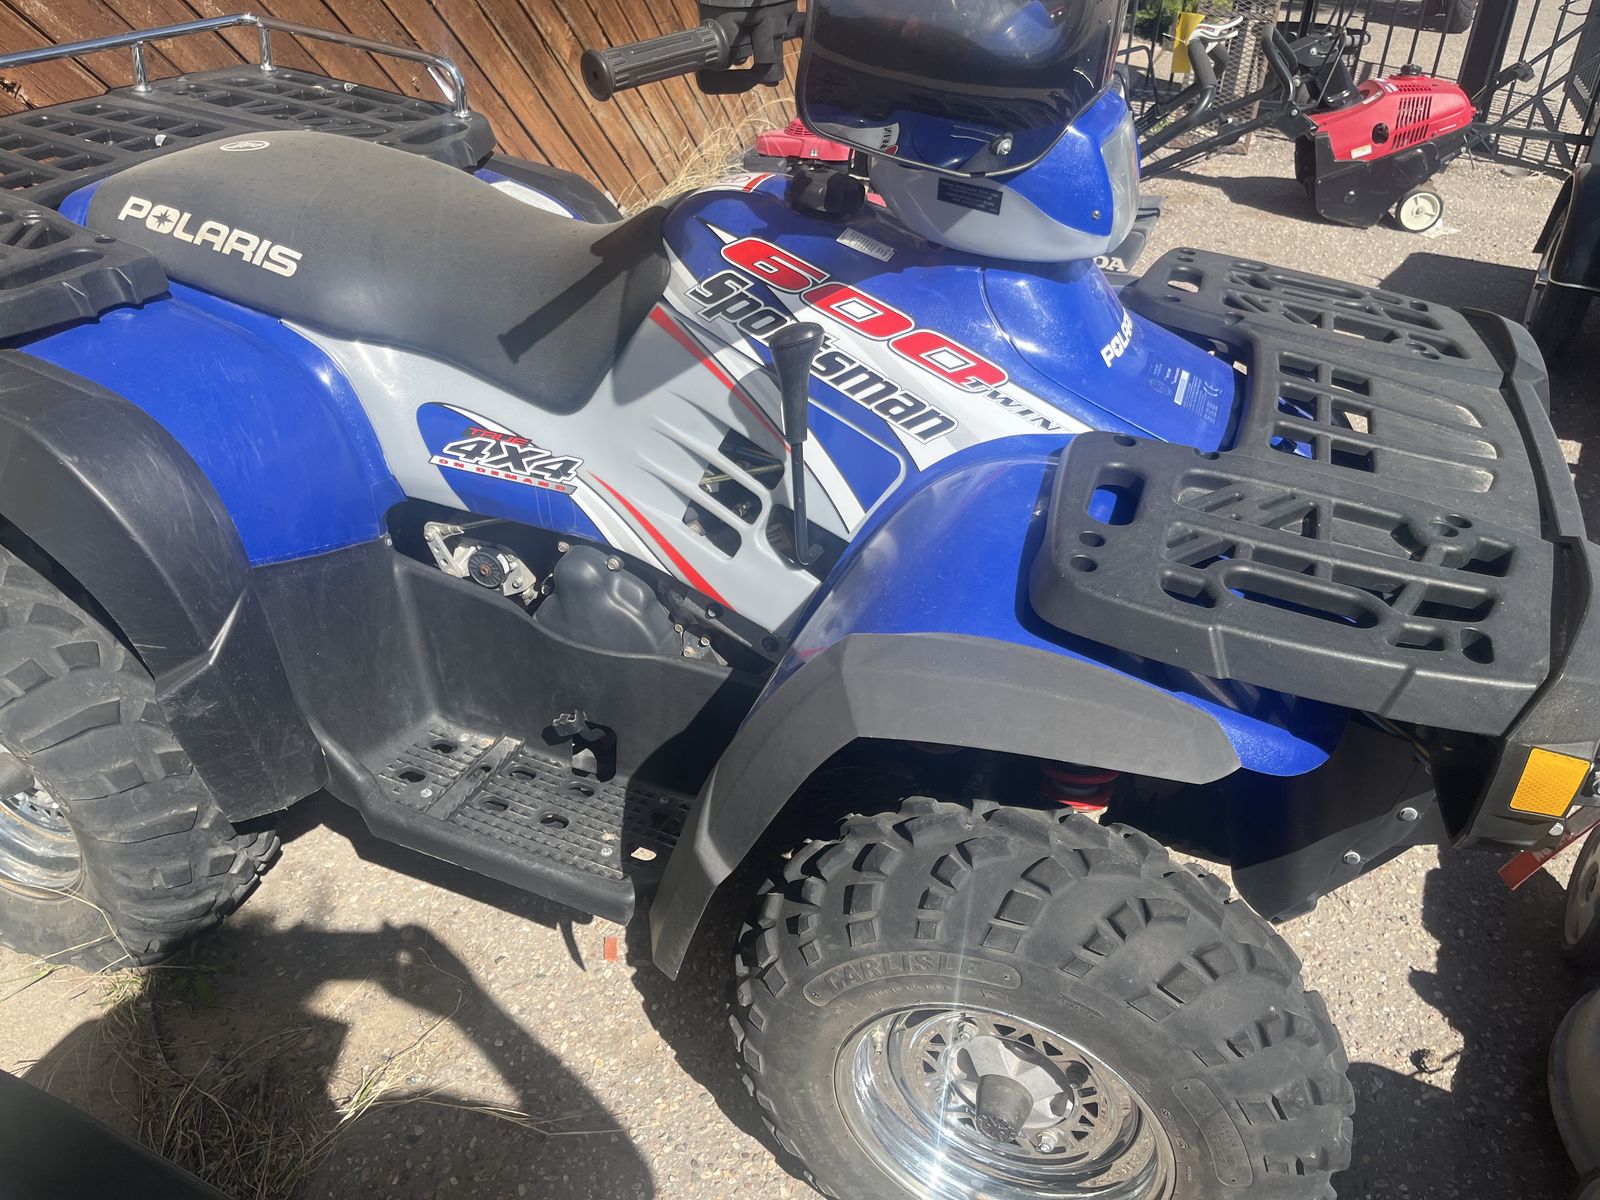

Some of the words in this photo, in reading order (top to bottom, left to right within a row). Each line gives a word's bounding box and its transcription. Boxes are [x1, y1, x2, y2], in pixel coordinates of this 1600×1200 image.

[117, 196, 303, 277] POLARIS
[721, 237, 1009, 393] 600
[958, 377, 1067, 431] TWIN
[468, 427, 529, 447] TRUE
[439, 458, 465, 468] ON
[476, 466, 566, 492] DEMAND
[823, 952, 983, 992] CARLISLE
